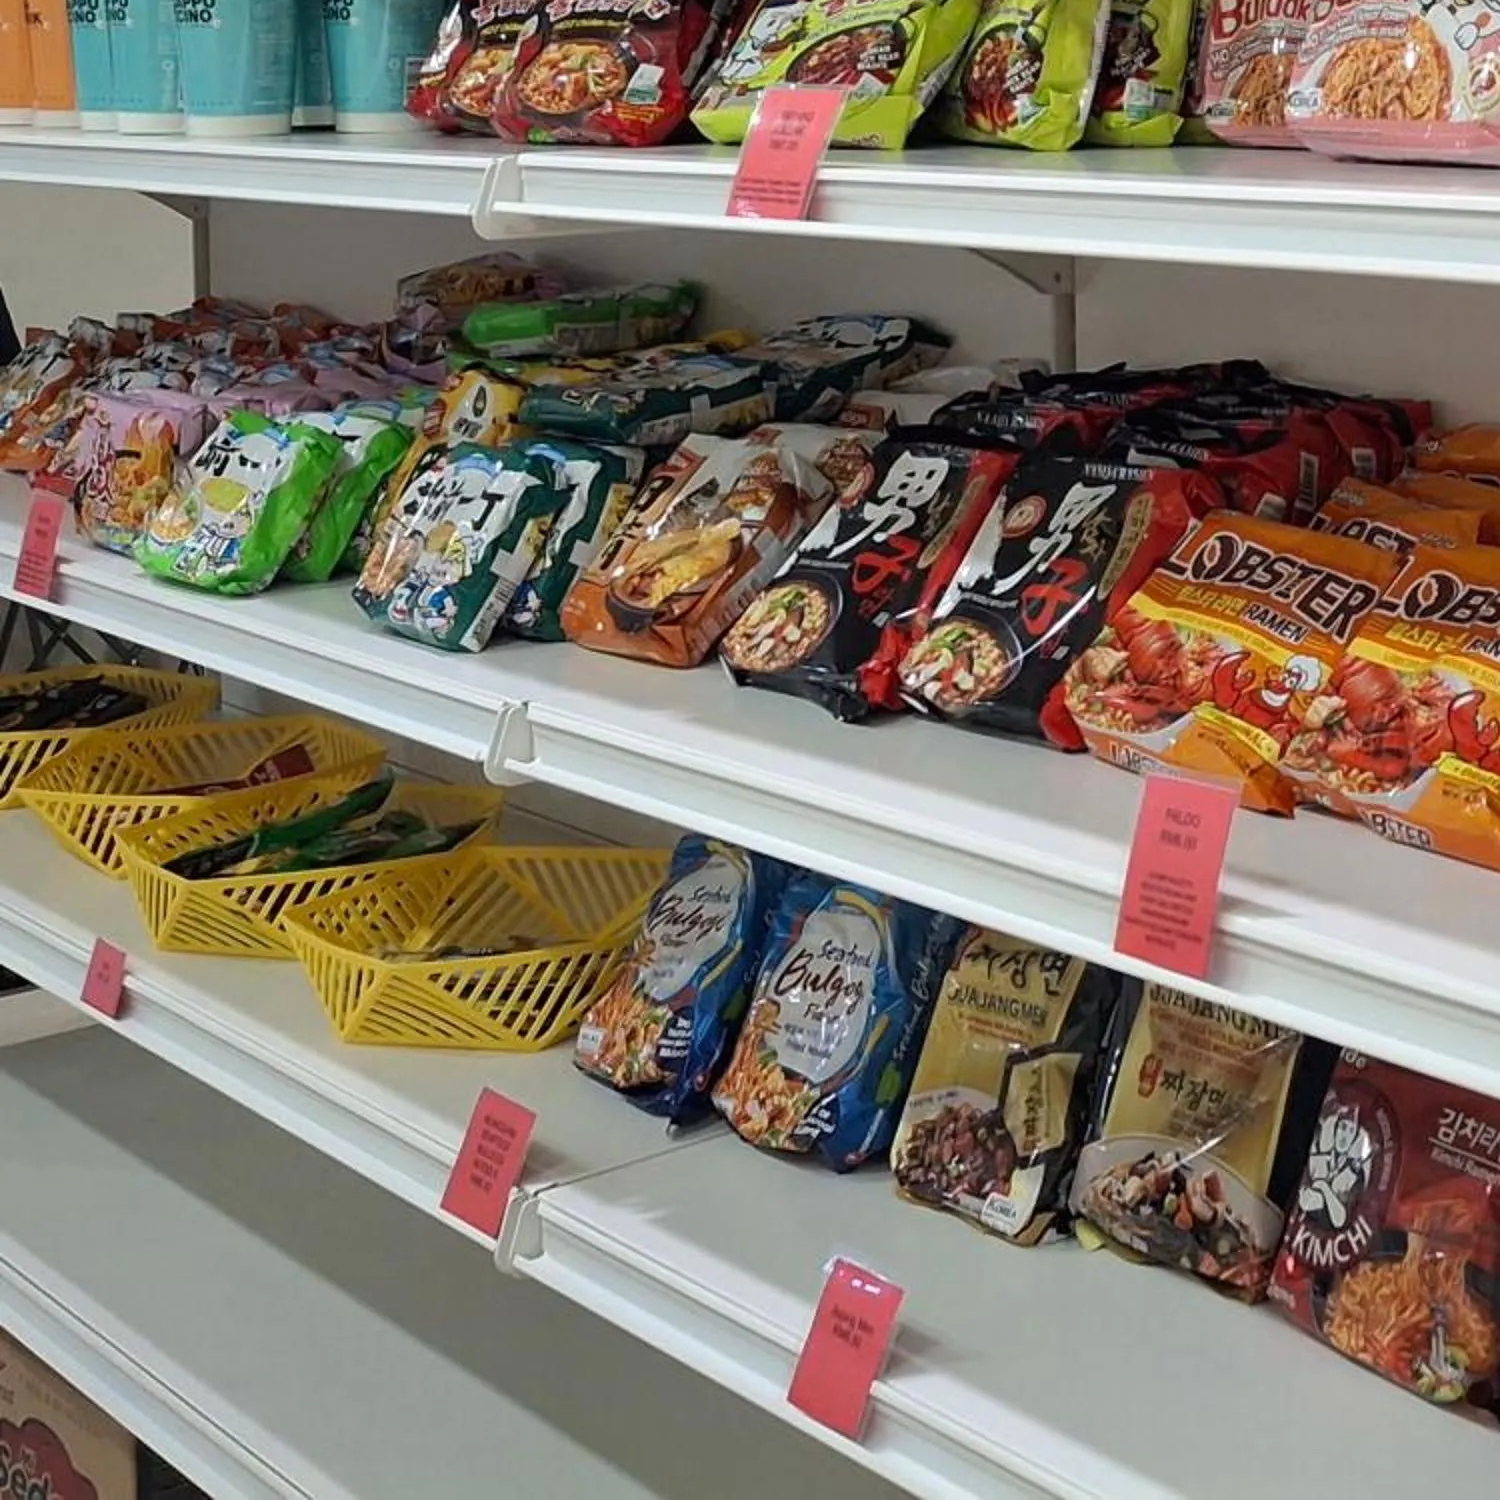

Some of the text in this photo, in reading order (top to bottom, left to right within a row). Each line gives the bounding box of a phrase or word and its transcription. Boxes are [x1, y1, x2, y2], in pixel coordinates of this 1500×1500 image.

[1156, 518, 1380, 644] LOBSTER
[1243, 603, 1311, 644] RAMEN
[1291, 1215, 1374, 1267] KIMCHI
